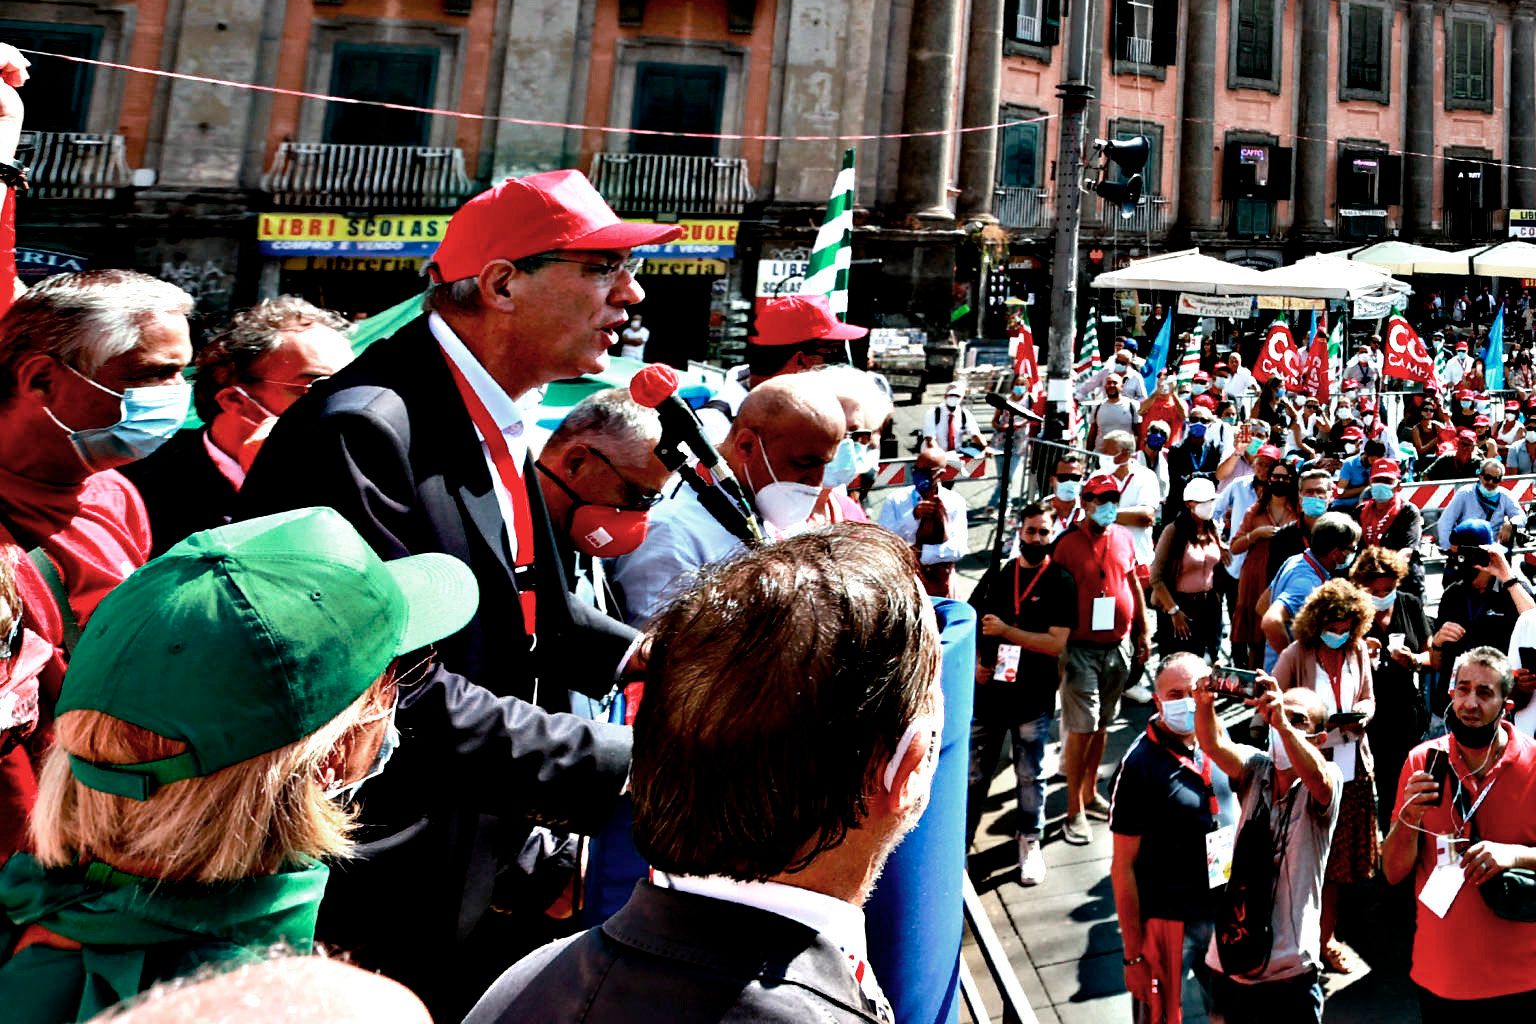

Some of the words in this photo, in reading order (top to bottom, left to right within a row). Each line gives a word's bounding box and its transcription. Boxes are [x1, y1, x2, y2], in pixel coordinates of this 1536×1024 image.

[262, 218, 336, 237] LIBRI
[347, 218, 450, 237] SCOLAS
[680, 223, 736, 240] CUOLE
[642, 257, 715, 275] breria
[772, 263, 809, 276] LIBR
